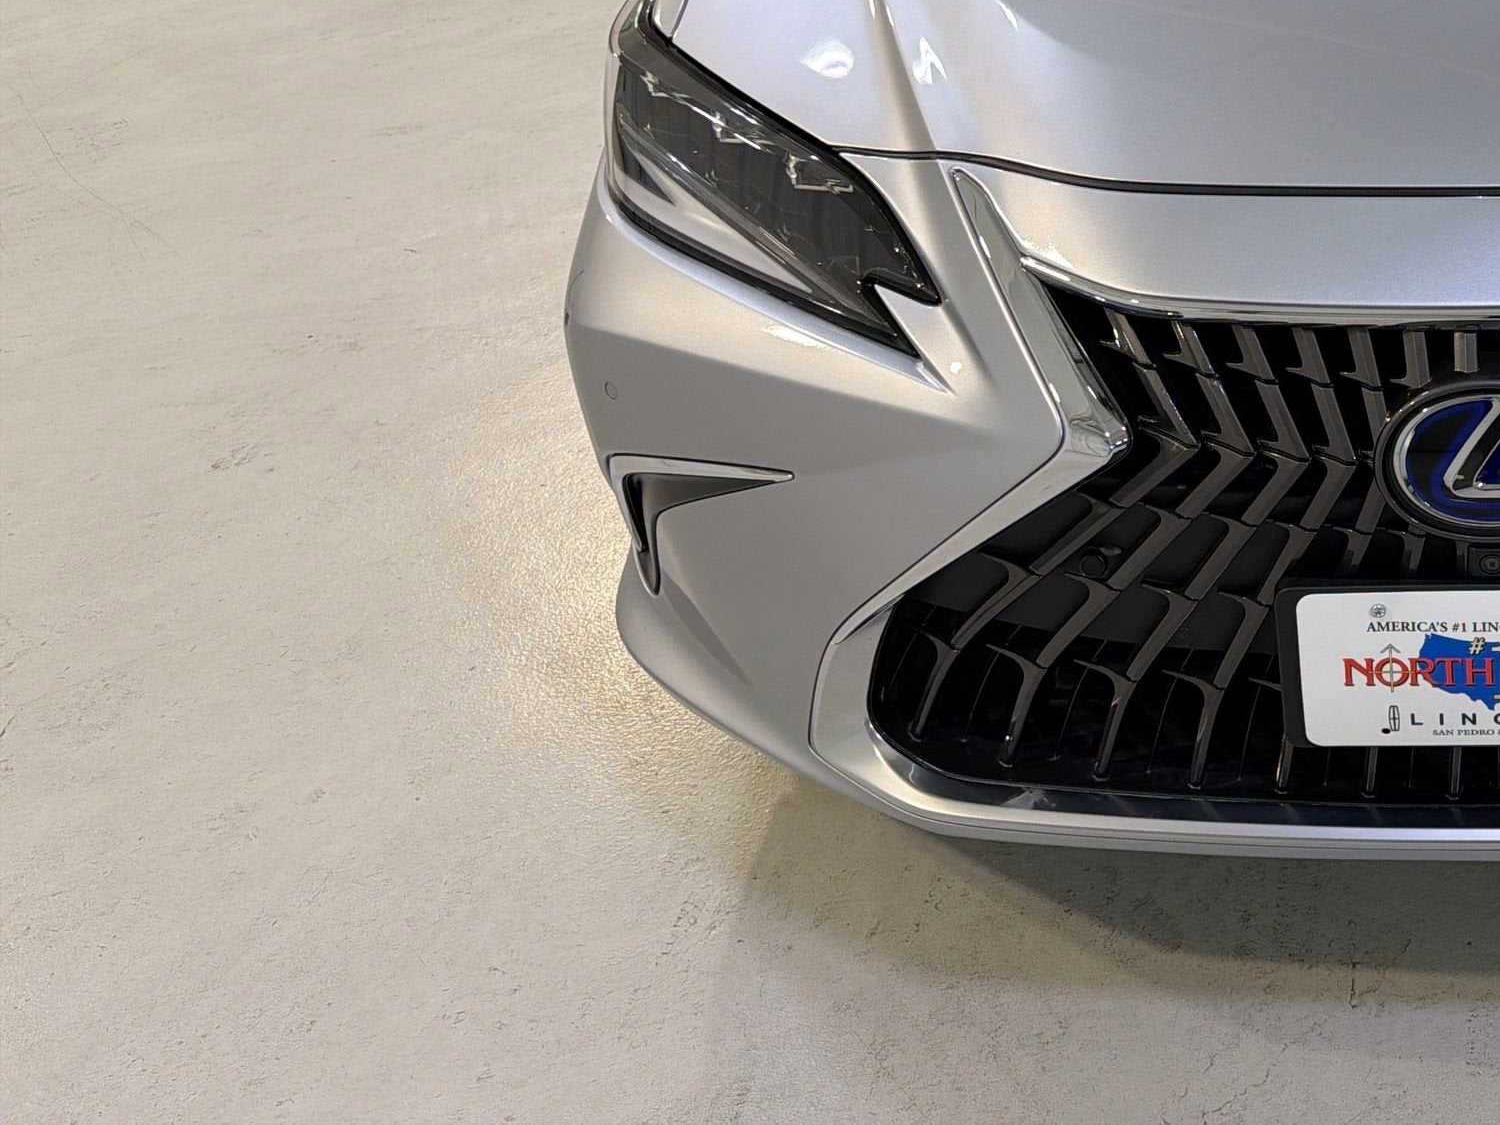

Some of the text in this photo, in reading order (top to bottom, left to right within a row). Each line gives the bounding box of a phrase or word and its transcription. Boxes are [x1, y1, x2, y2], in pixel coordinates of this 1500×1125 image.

[1366, 620, 1448, 633] AMERICA'S
[1452, 622, 1467, 632] #1
[1342, 656, 1495, 687] NORTH
